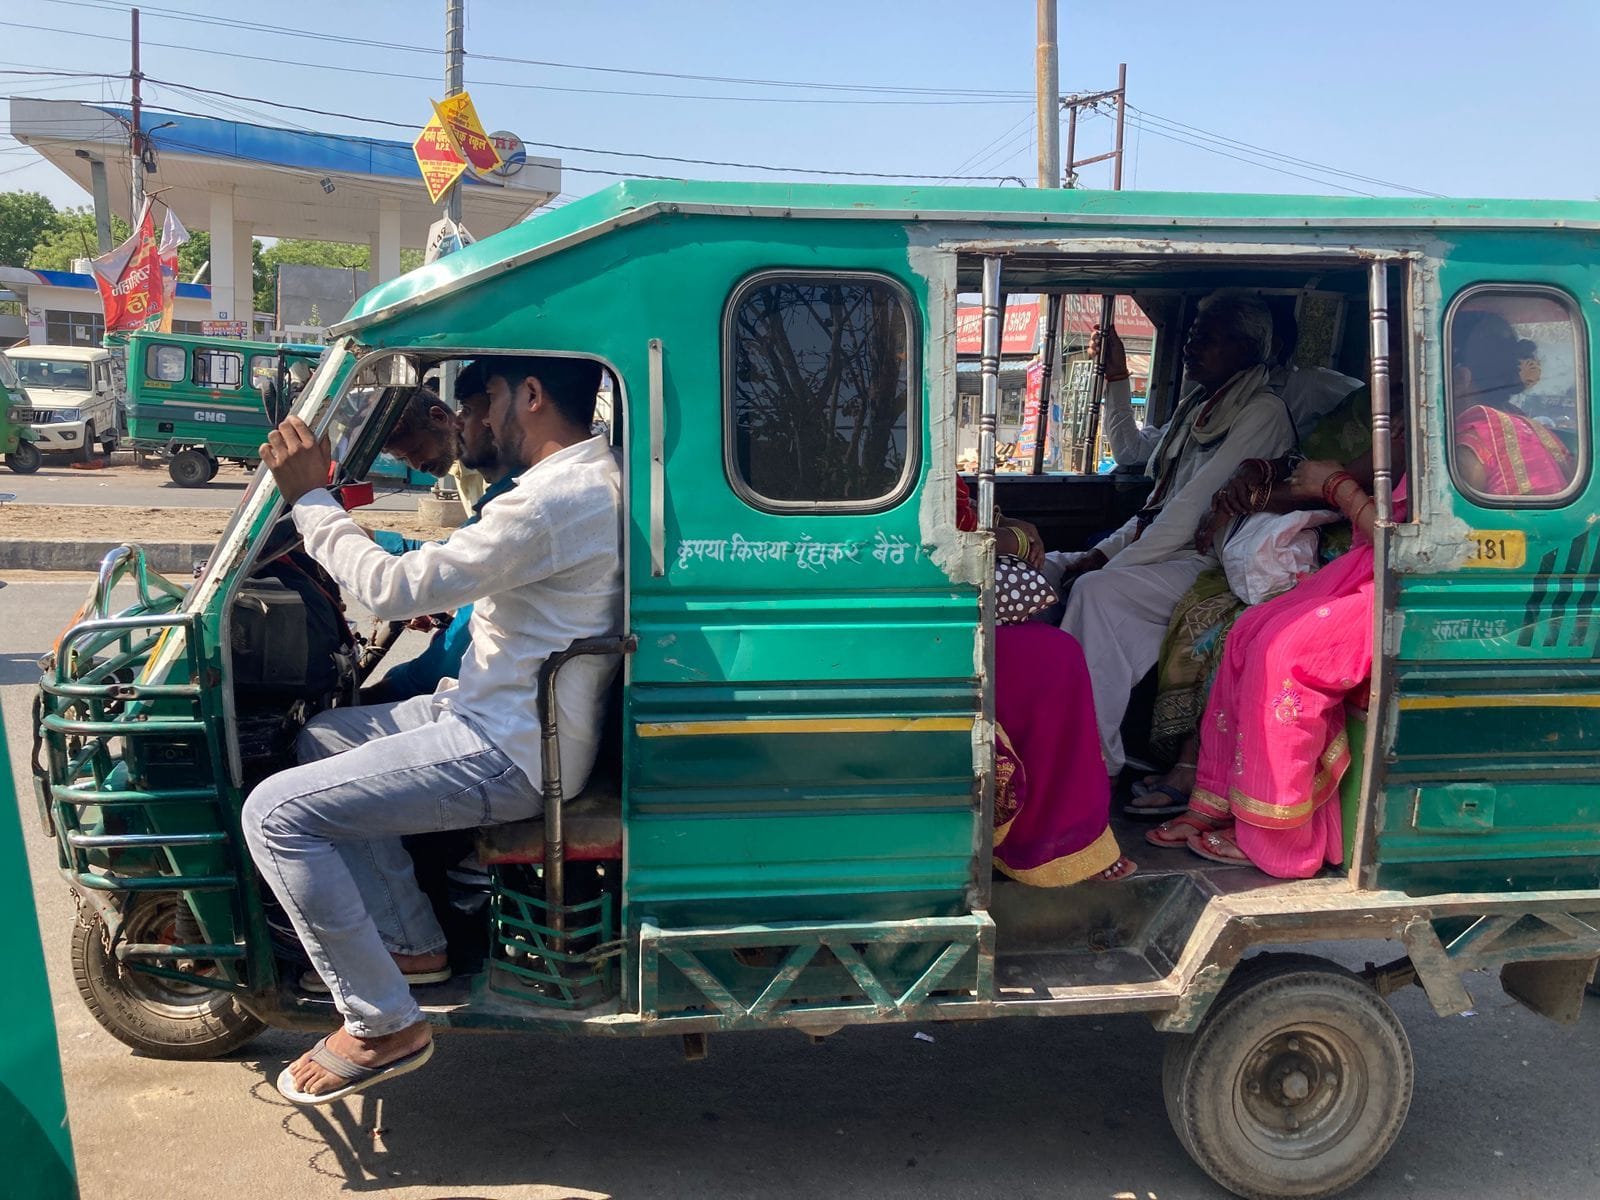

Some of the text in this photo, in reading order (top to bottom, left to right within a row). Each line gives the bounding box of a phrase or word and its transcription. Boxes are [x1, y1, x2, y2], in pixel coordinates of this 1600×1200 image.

[1065, 294, 1102, 314] NGLISH
[1008, 311, 1031, 332] SHOP
[193, 411, 227, 423] CNG
[677, 539, 729, 569] कृपया
